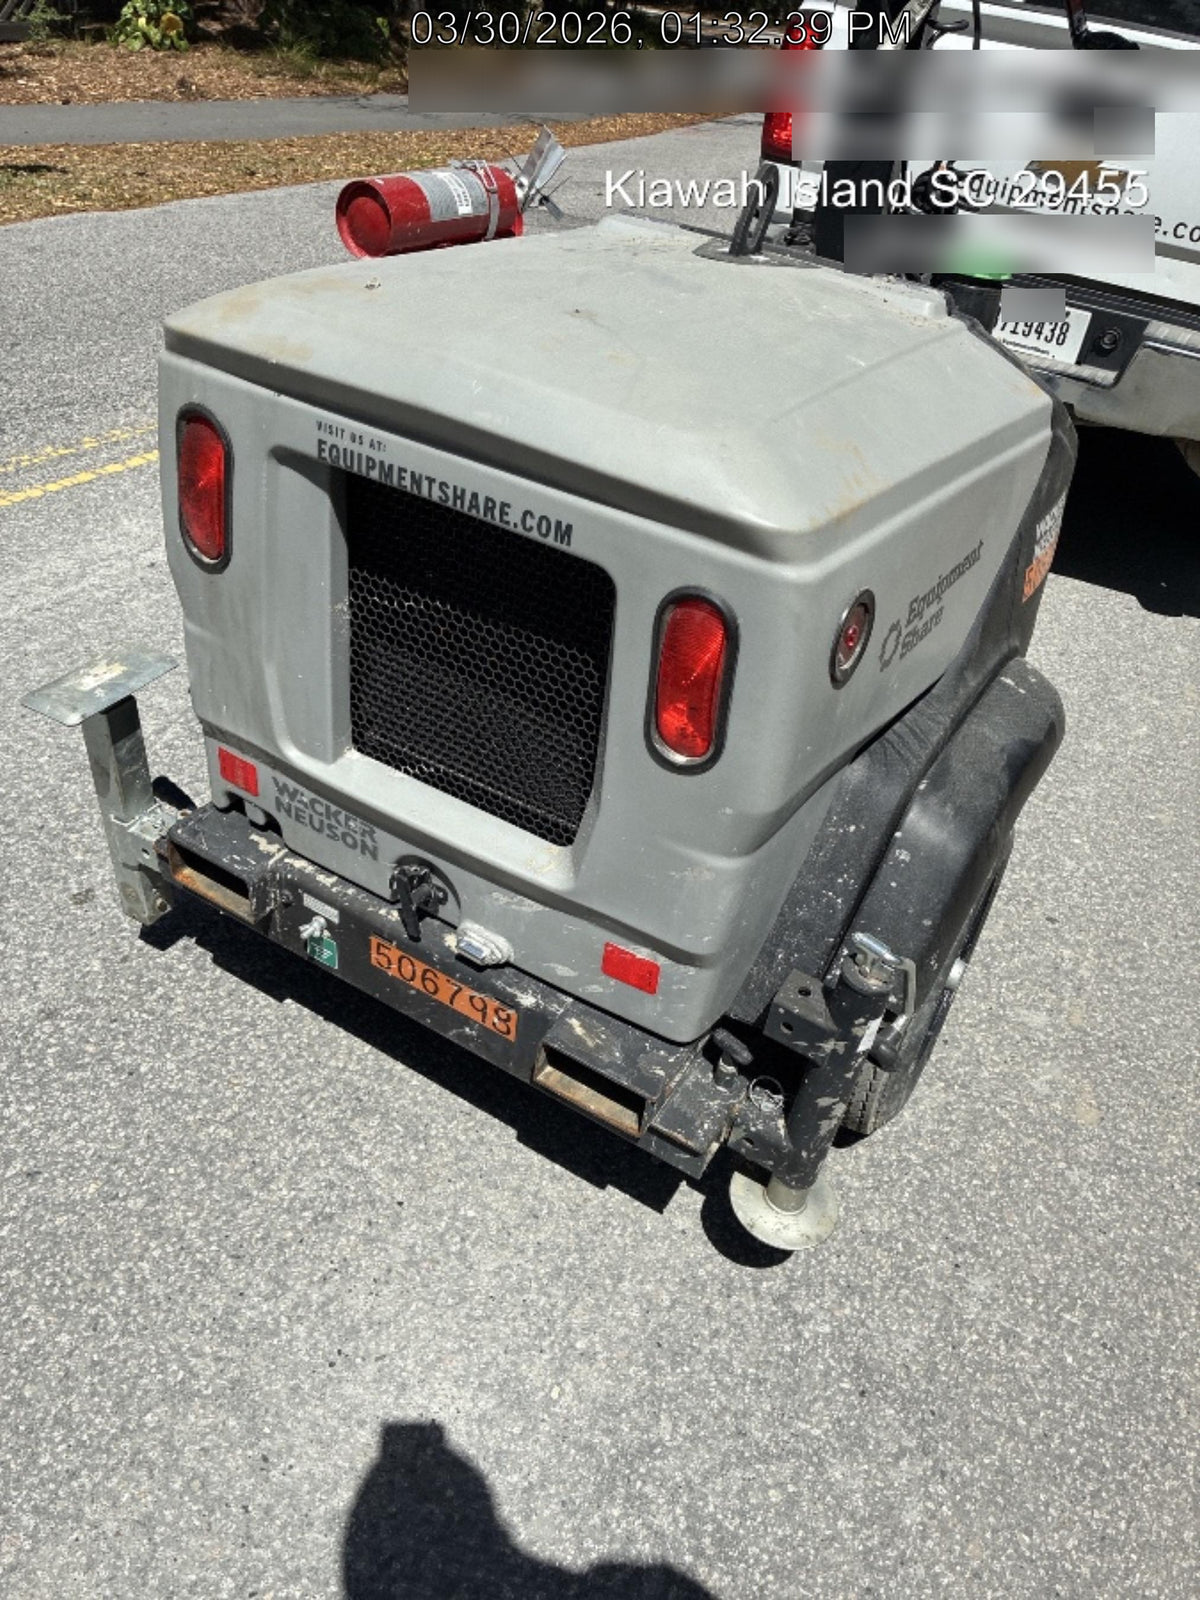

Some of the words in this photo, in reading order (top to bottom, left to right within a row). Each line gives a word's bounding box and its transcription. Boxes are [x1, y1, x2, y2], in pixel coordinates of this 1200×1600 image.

[316, 420, 346, 440] VISIT
[350, 432, 364, 446] US
[369, 438, 387, 452] AT:
[317, 438, 574, 548] EQUIPMENTSHARE.COM
[905, 539, 984, 628] Equipment
[899, 605, 945, 660] Share
[271, 776, 378, 844] WACKER
[274, 796, 379, 861] NEUSON
[376, 942, 512, 1037] 506798
